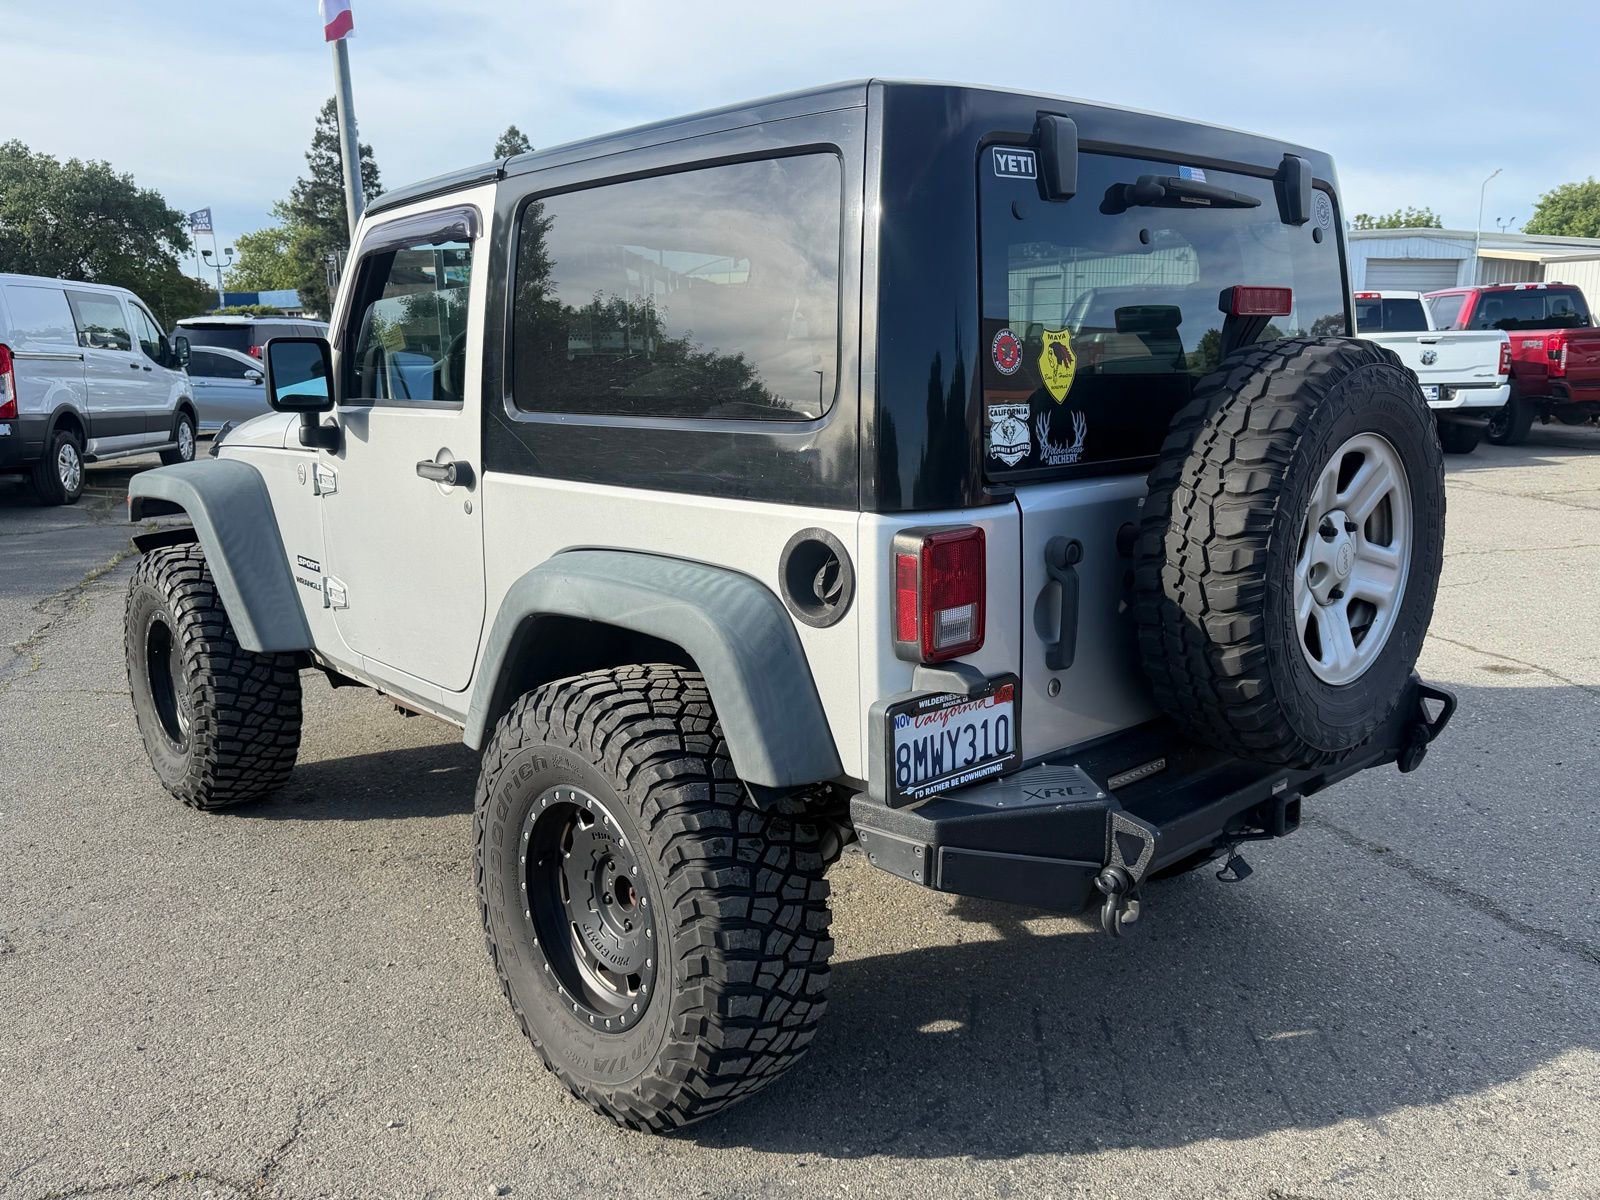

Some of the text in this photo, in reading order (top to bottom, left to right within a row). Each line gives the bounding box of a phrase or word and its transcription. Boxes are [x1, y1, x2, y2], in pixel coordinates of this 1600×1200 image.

[996, 154, 1033, 173] YETI
[993, 331, 1021, 353] NATIONAL RIFLE
[1047, 333, 1067, 341] MAYA
[995, 357, 1021, 374] ASSOCIATION
[989, 407, 1028, 417] CALIFORNIA
[1040, 445, 1085, 461] Wilderness
[1048, 453, 1078, 466] ARCHERY
[298, 557, 321, 571] SPORT
[295, 575, 322, 592] WRANGLE
[894, 714, 911, 730] NOV
[914, 698, 995, 729] California
[896, 714, 1009, 787] 8MWY310
[915, 763, 1003, 799] I'D RATHER BE BOWHUNTING!
[1022, 786, 1088, 801] XRC
[582, 923, 630, 966] PRO COMP
